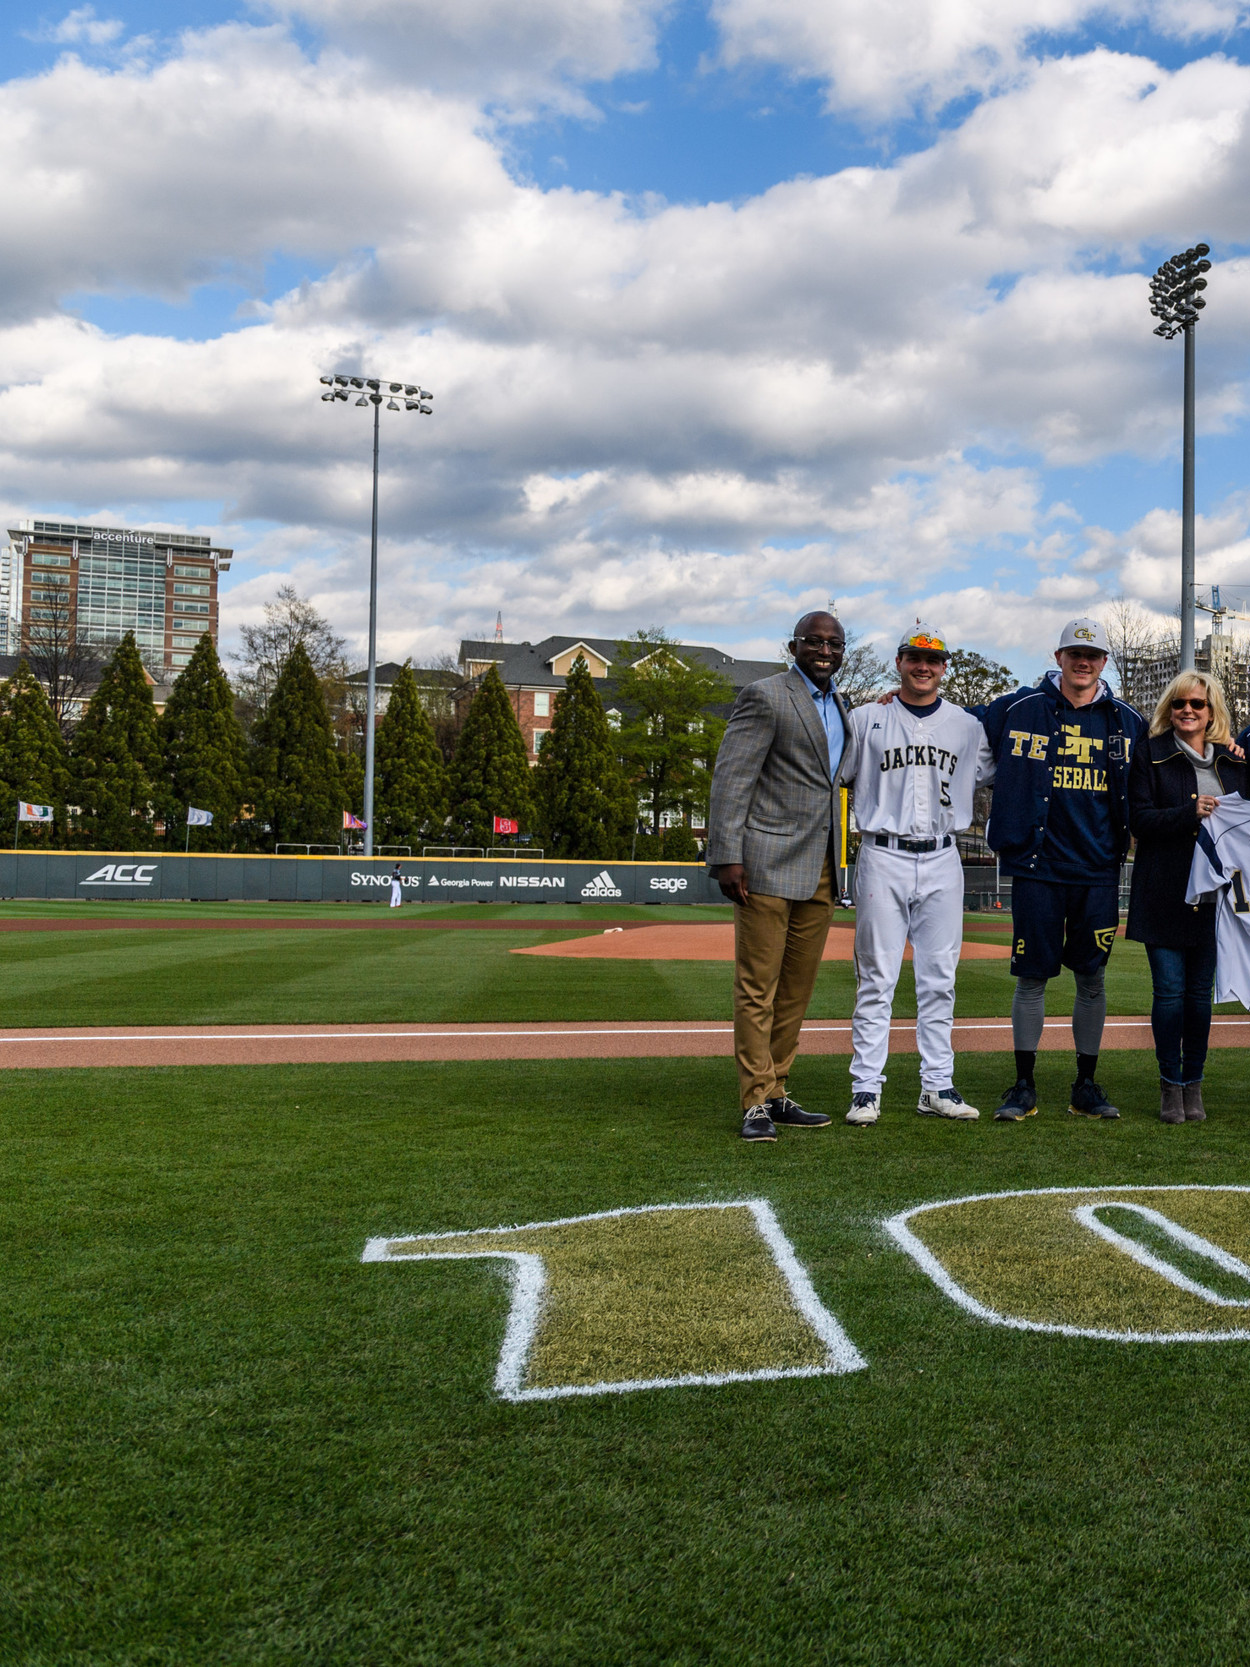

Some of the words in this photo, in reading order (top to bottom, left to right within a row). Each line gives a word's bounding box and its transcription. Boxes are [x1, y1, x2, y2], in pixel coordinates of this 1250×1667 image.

[93, 530, 154, 544] accenture
[880, 745, 958, 776] JACKETS
[939, 780, 952, 807] 5
[85, 864, 158, 882] ACC
[351, 872, 420, 888] SYNOUS
[441, 878, 470, 888] Georgia
[471, 879, 494, 887] Power
[500, 876, 565, 888] NISSAN
[650, 877, 688, 893] sage
[581, 887, 622, 897] adidas
